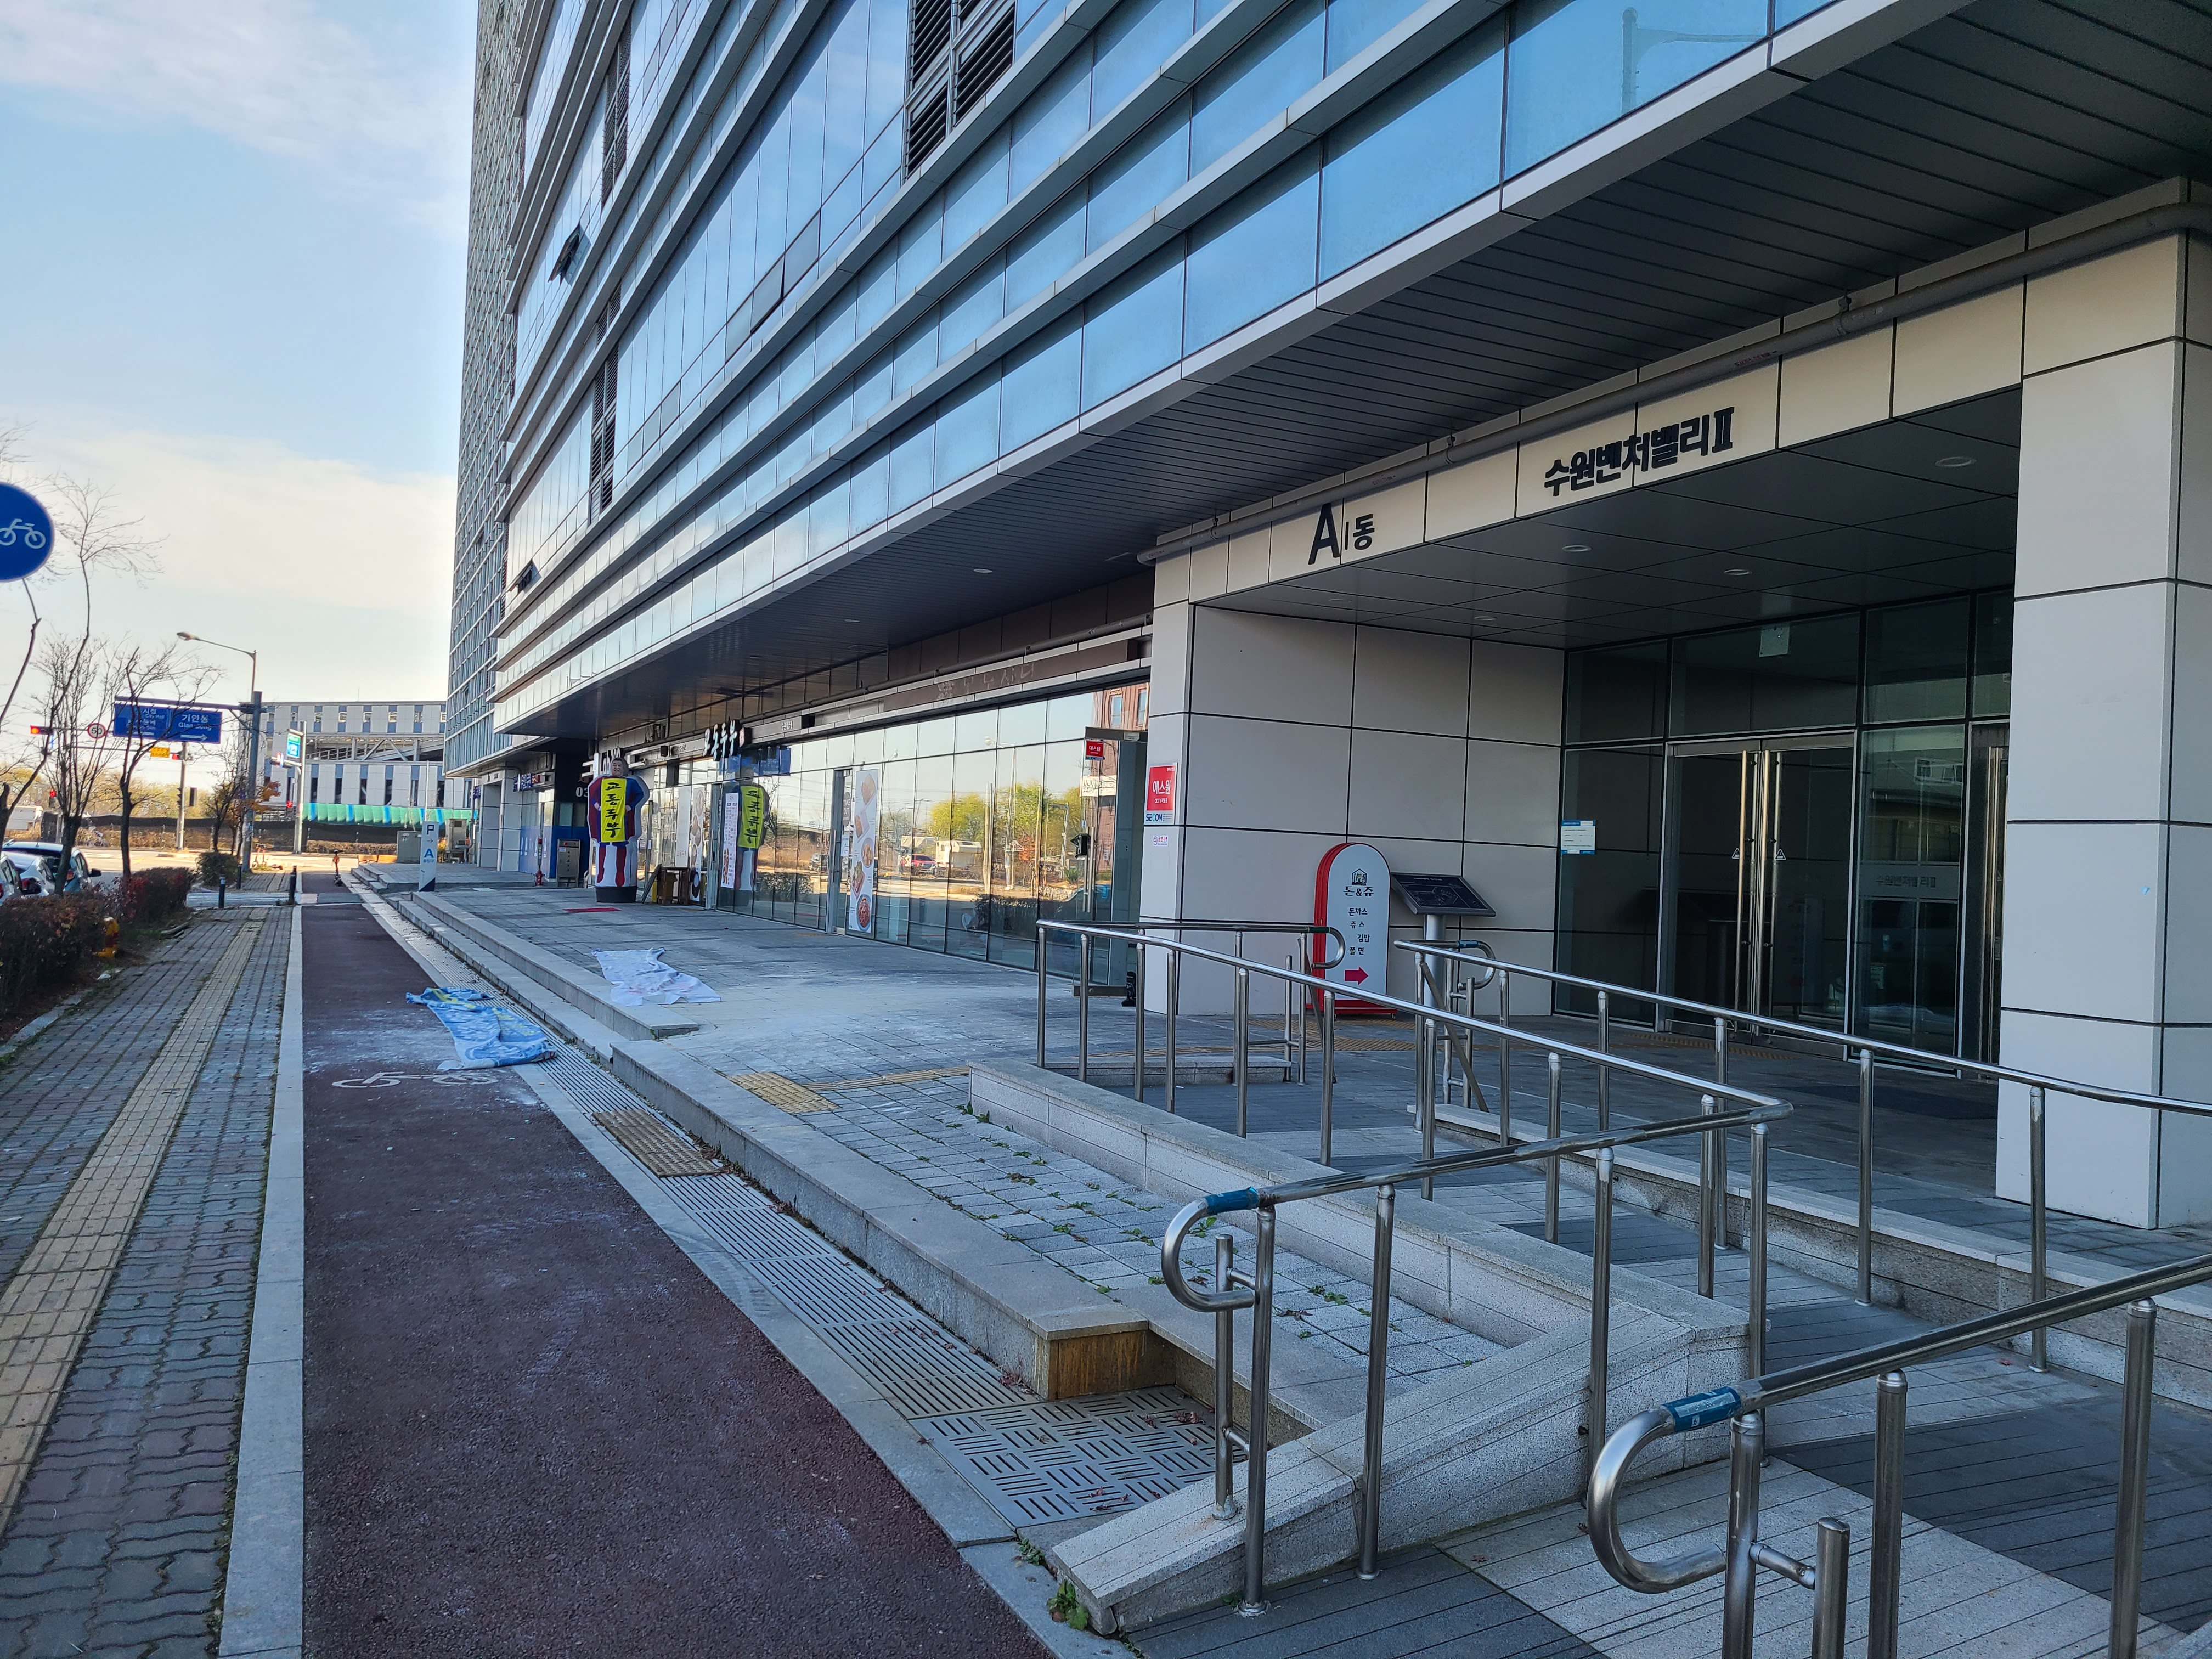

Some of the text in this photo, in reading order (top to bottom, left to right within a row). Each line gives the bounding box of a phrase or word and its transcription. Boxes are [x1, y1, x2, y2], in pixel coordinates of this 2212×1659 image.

[182, 714, 208, 723] 기안동
[1153, 780, 1171, 795] 에스원
[605, 782, 622, 838] 교동두부
[1146, 814, 1163, 822] SECOM
[426, 825, 435, 835] P
[424, 848, 434, 858] A
[1343, 886, 1374, 897] 돈&쥬
[1348, 907, 1368, 916] 돈까스
[1357, 934, 1370, 943] 김밥
